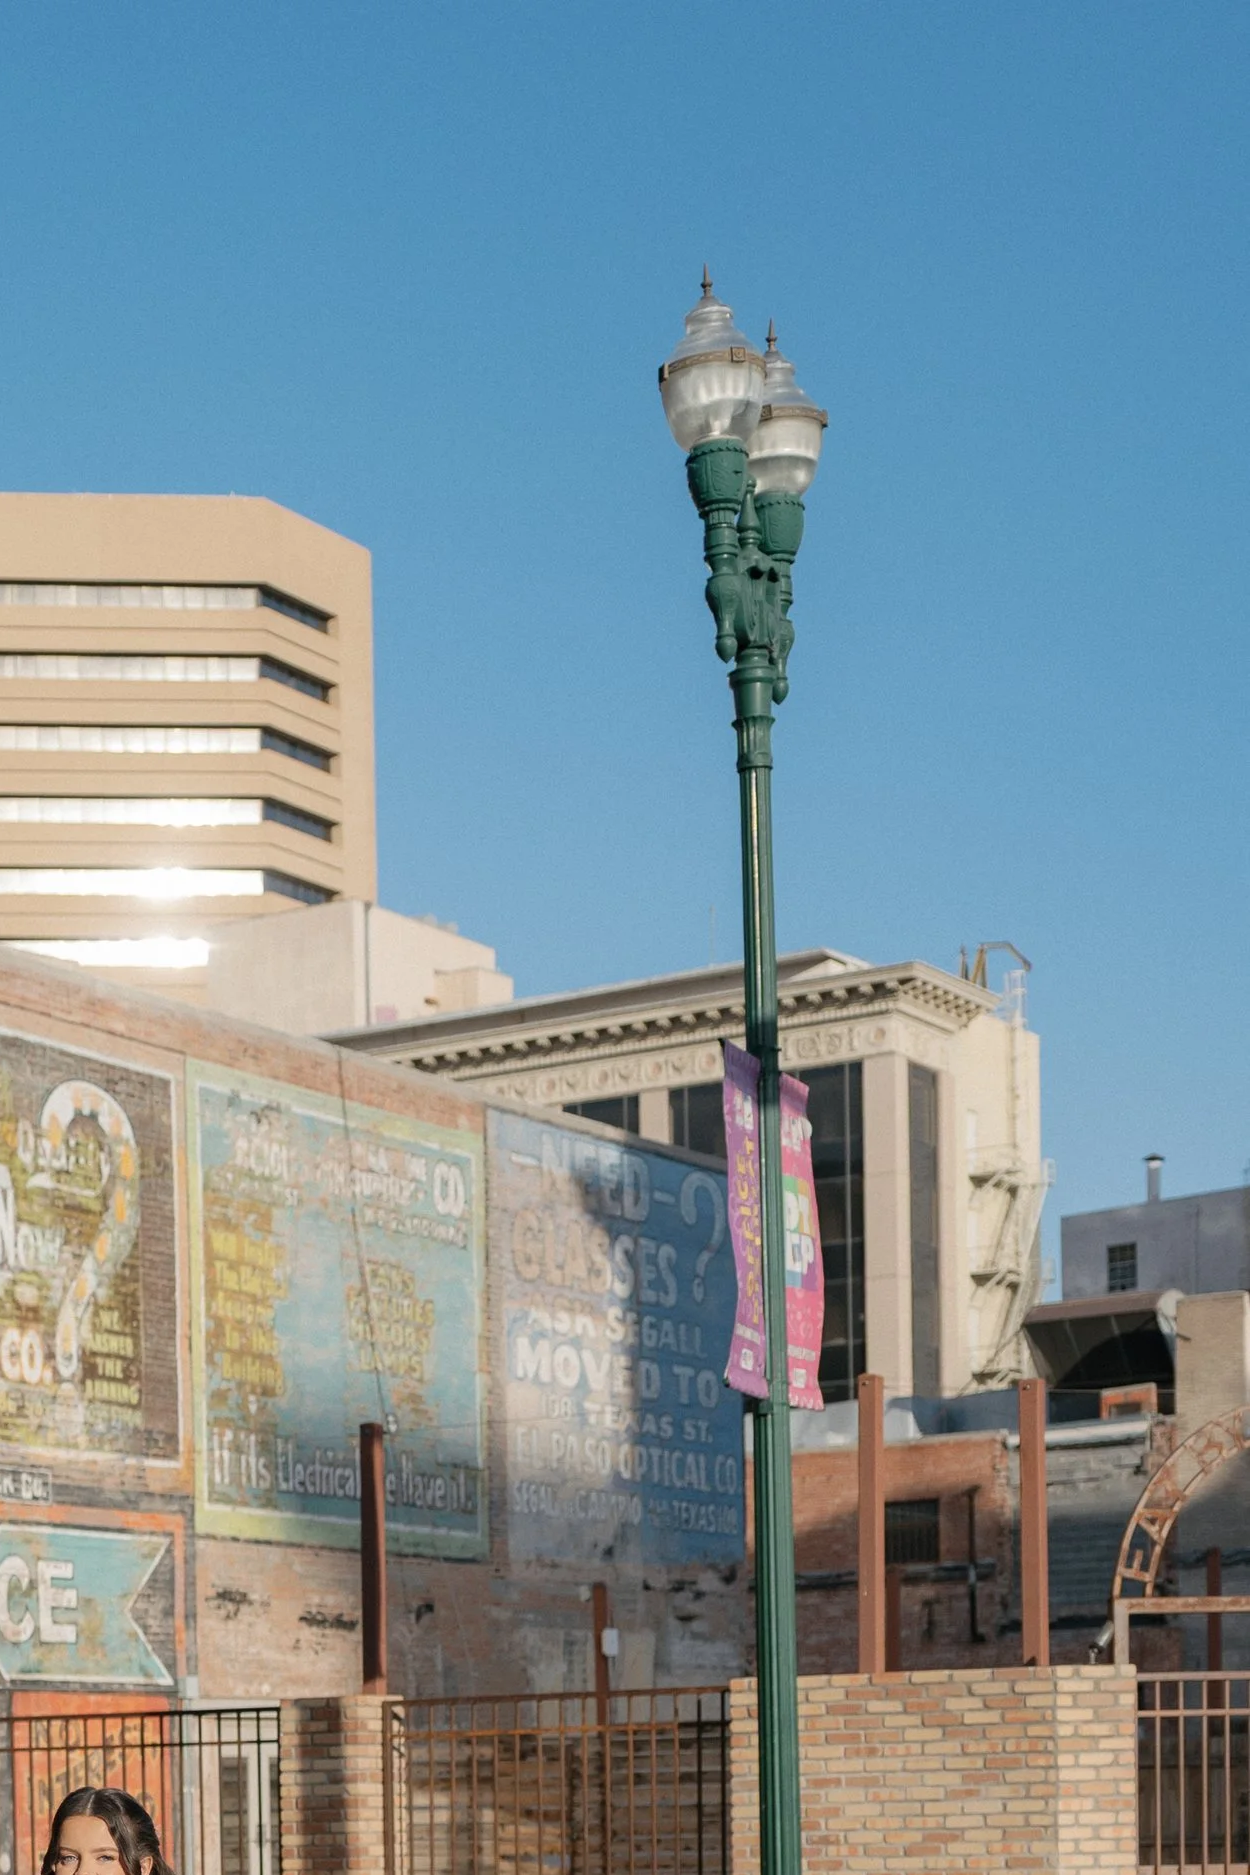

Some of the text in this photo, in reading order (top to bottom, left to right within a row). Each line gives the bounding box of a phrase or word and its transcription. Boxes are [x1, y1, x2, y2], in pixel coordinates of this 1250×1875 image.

[513, 1209, 679, 1309] GLASSES
[0, 1326, 54, 1388] CO.
[516, 1335, 721, 1409] MOVED TO
[584, 1401, 675, 1441] TEXAS
[516, 1425, 545, 1467] EL
[551, 1431, 612, 1477] PASO
[618, 1442, 712, 1493] OPTICAL
